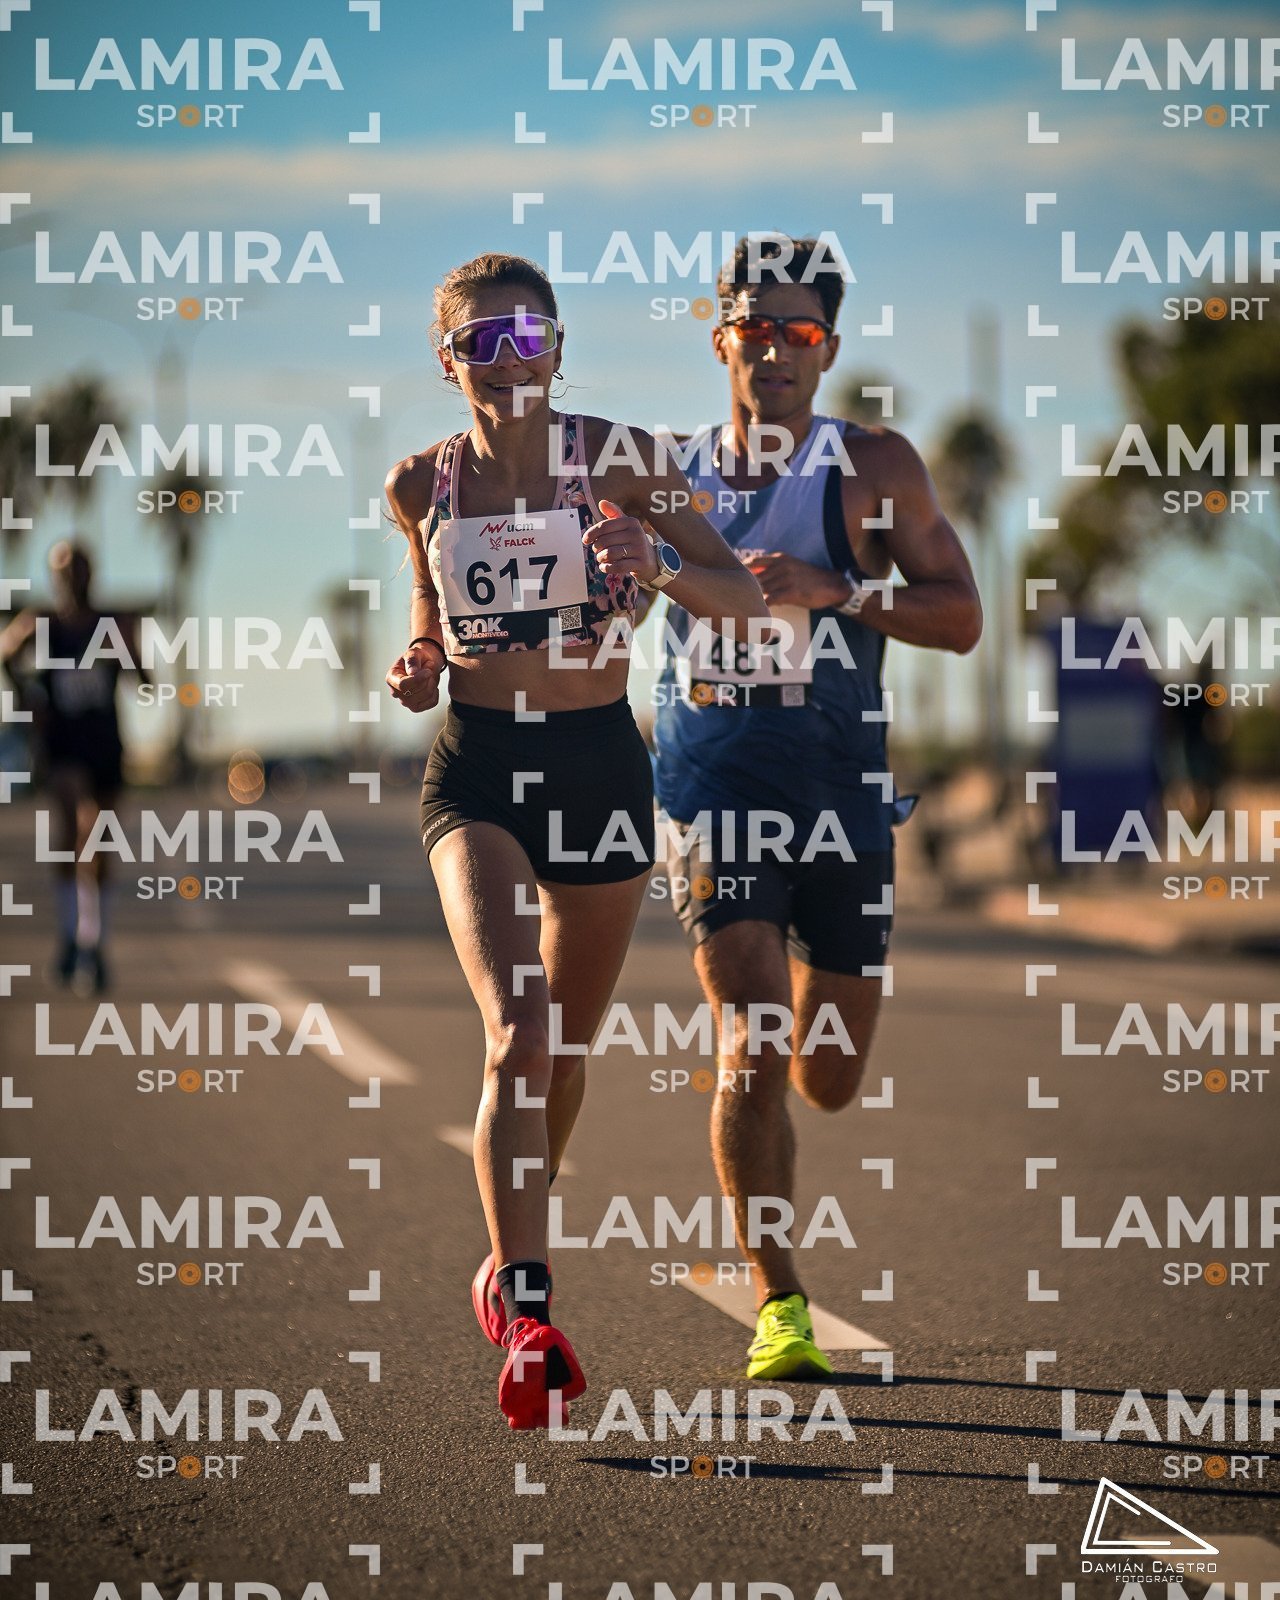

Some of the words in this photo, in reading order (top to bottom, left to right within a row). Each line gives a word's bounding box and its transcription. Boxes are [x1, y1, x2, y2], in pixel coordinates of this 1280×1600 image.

[507, 522, 534, 533] ucm
[504, 537, 536, 548] FALCK
[466, 555, 559, 606] 617
[458, 616, 503, 641] 30K
[706, 634, 782, 677] 481
